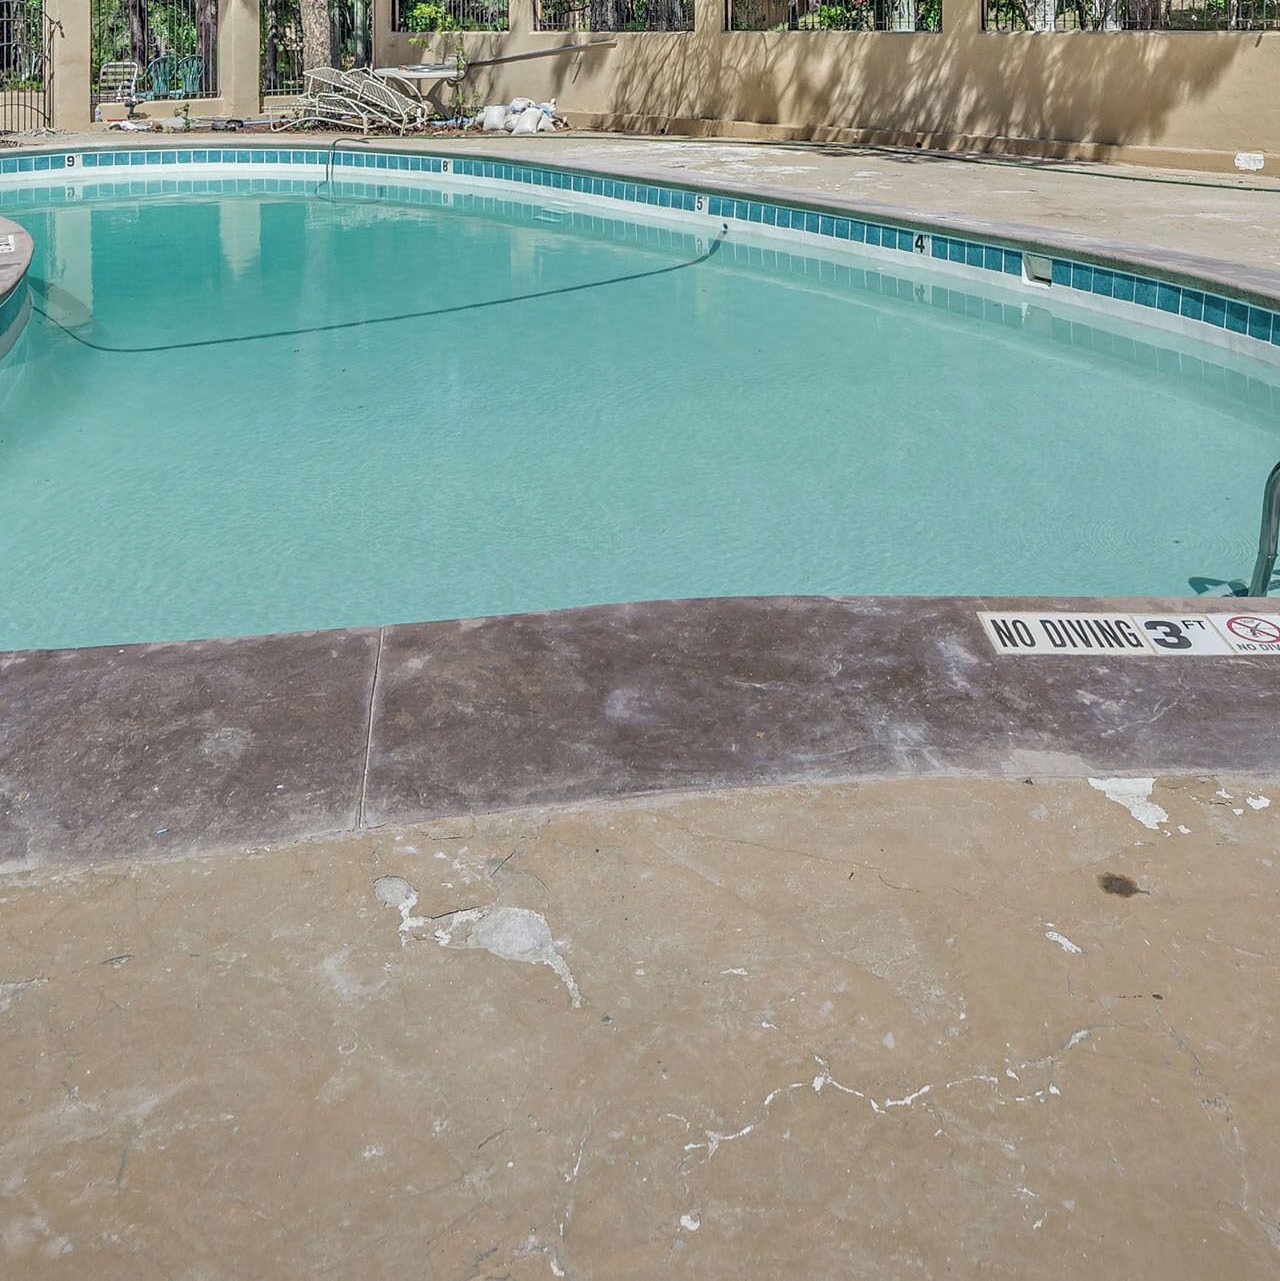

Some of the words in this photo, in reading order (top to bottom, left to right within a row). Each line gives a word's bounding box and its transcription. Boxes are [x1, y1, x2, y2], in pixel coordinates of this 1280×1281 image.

[67, 155, 74, 167] 9
[442, 160, 448, 172] 8
[696, 196, 703, 210] 5
[915, 234, 925, 253] 4
[990, 619, 1036, 648] NO
[1039, 619, 1144, 648] DIVING
[1144, 620, 1192, 649] 3
[1181, 620, 1206, 630] FT
[1236, 643, 1257, 651] NO
